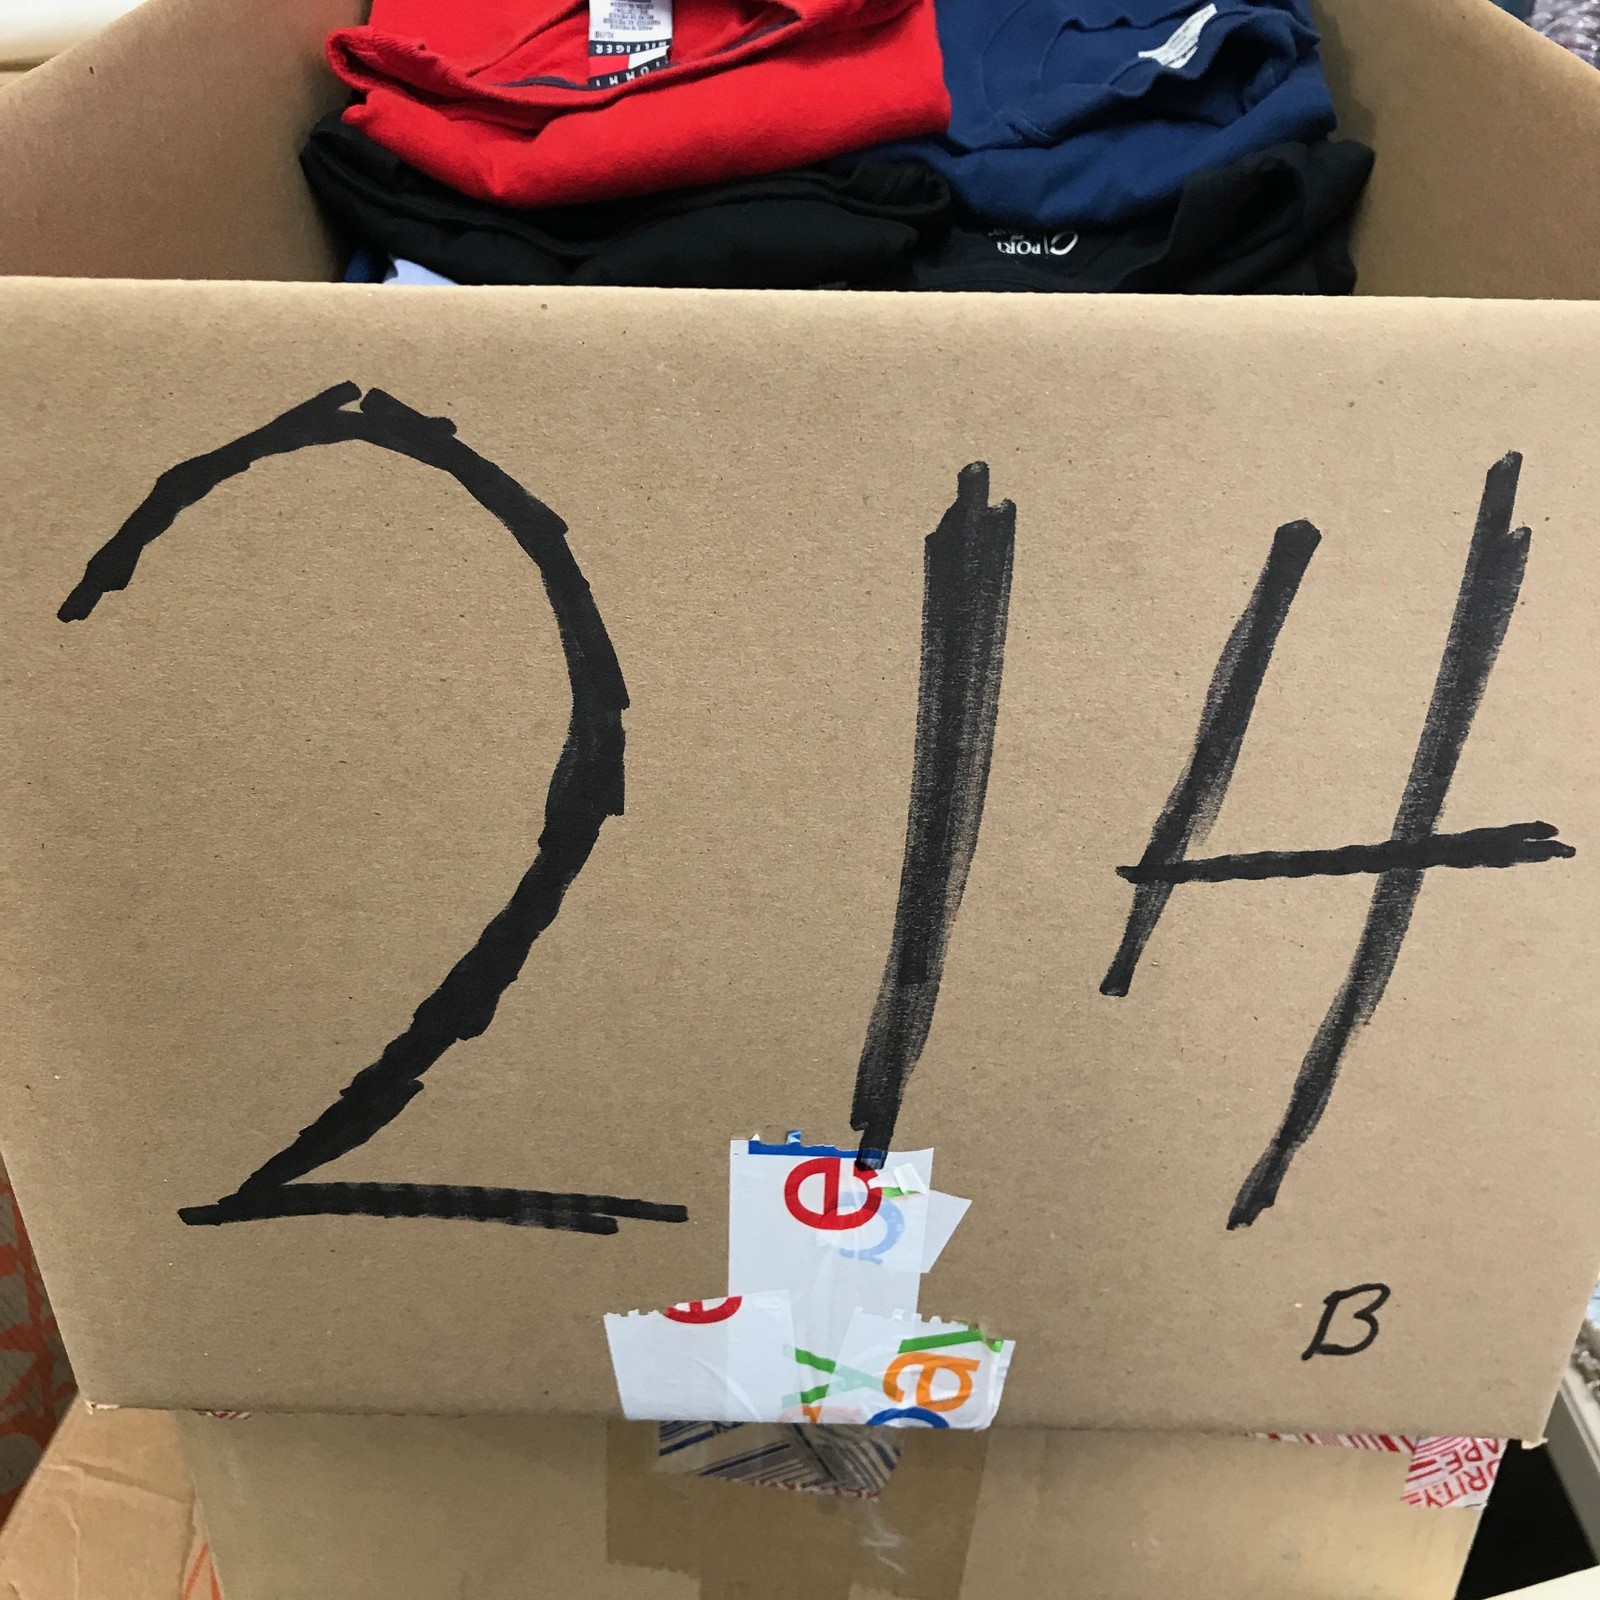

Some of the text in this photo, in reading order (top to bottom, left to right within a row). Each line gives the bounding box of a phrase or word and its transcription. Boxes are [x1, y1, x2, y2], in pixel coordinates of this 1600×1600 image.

[595, 41, 668, 54] HILFIGER
[58, 380, 1576, 1232] 214
[1300, 1282, 1391, 1361] B
